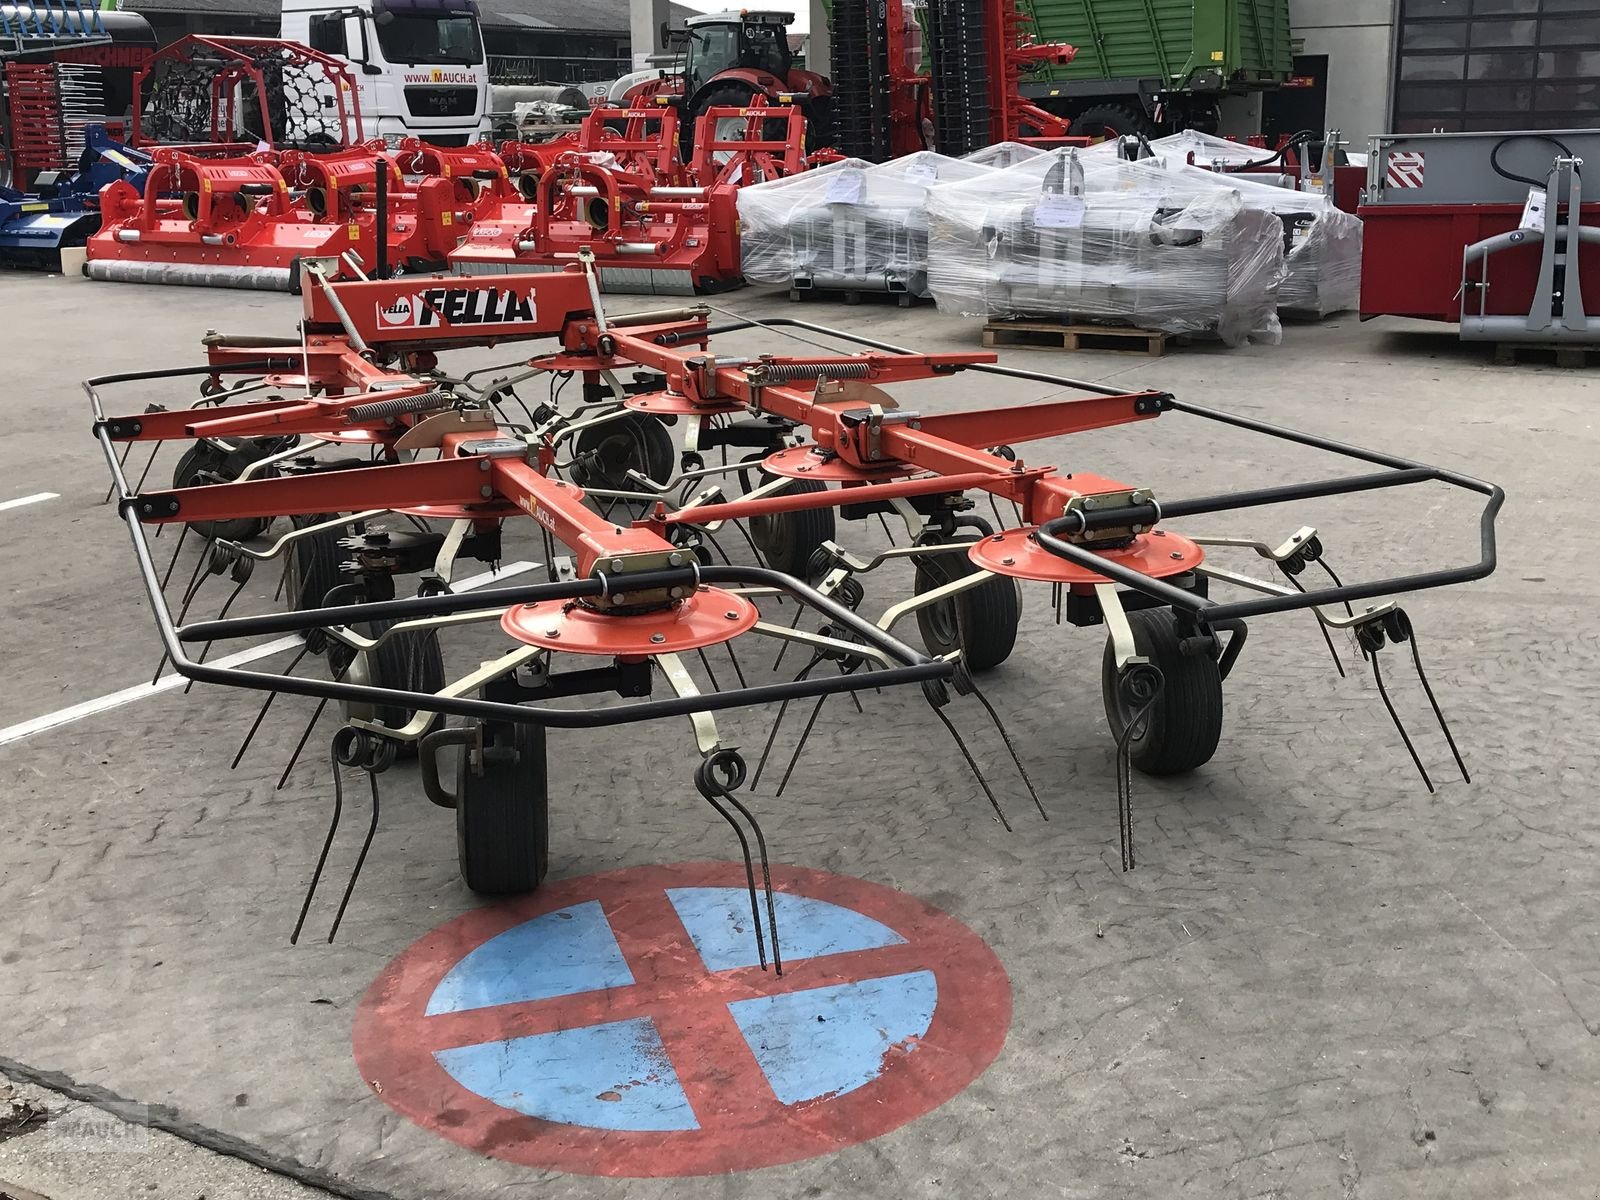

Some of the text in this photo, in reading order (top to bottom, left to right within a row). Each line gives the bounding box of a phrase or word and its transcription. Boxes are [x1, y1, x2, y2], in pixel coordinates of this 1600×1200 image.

[404, 72, 477, 83] www.MAUCH.at
[429, 97, 457, 105] MAN
[419, 287, 534, 326] FELLA
